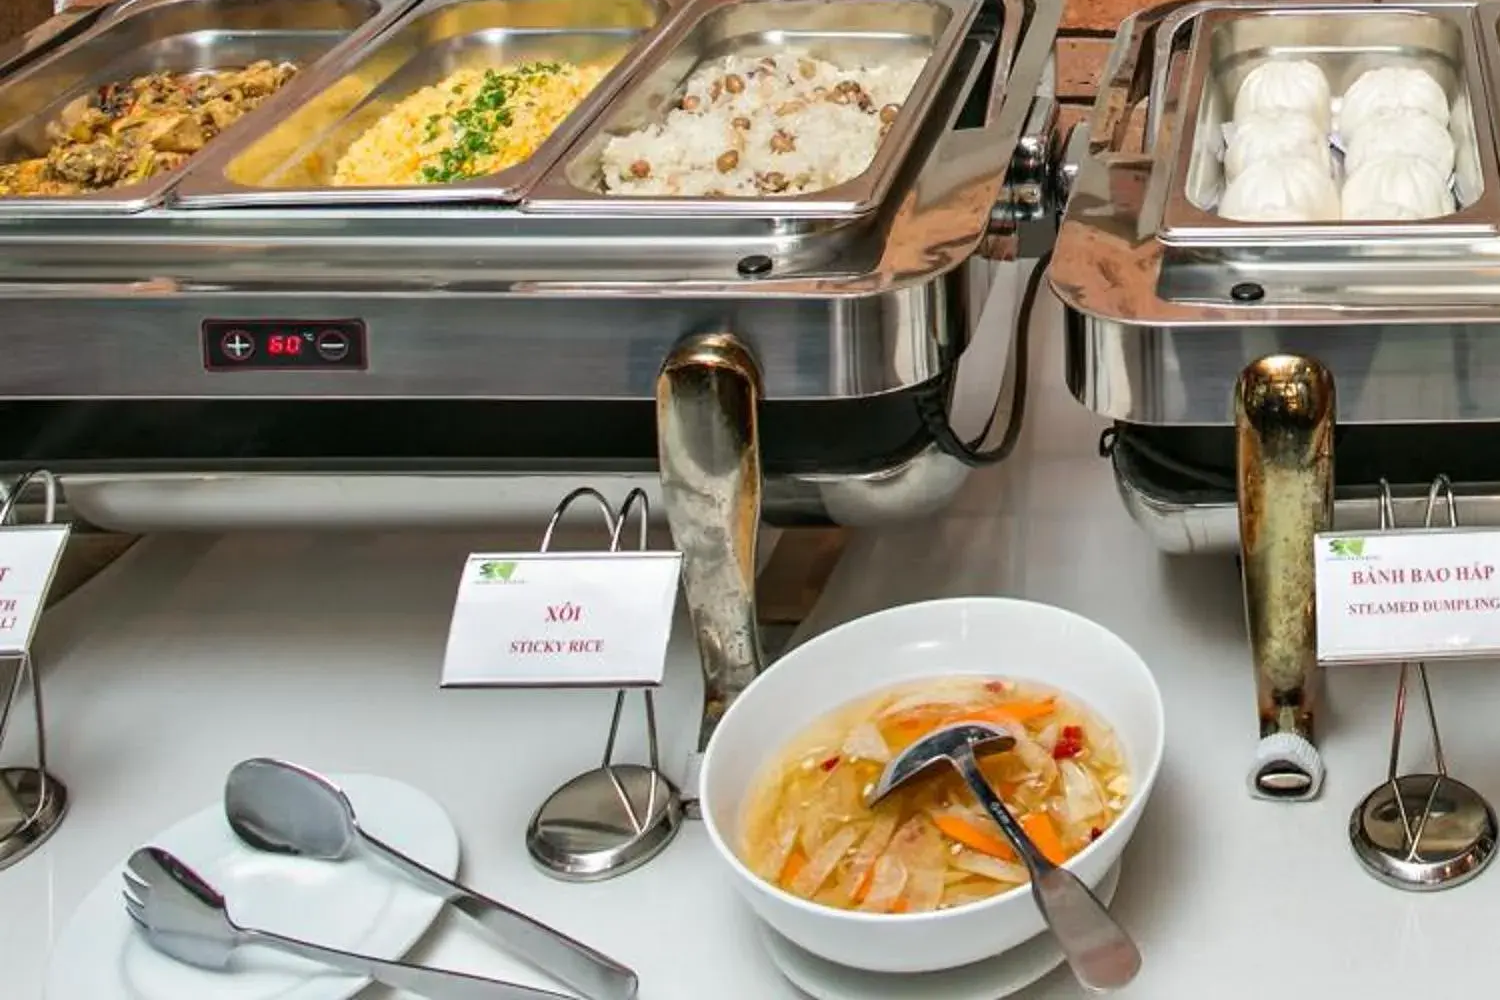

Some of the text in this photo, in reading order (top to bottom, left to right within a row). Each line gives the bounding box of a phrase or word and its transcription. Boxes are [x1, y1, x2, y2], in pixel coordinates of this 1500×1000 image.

[268, 335, 302, 355] 60
[1411, 568, 1450, 583] BAO
[545, 602, 581, 622] XÔI
[1348, 598, 1500, 615] STEAMED DUMPLING
[510, 639, 604, 653] STICKY RICE
